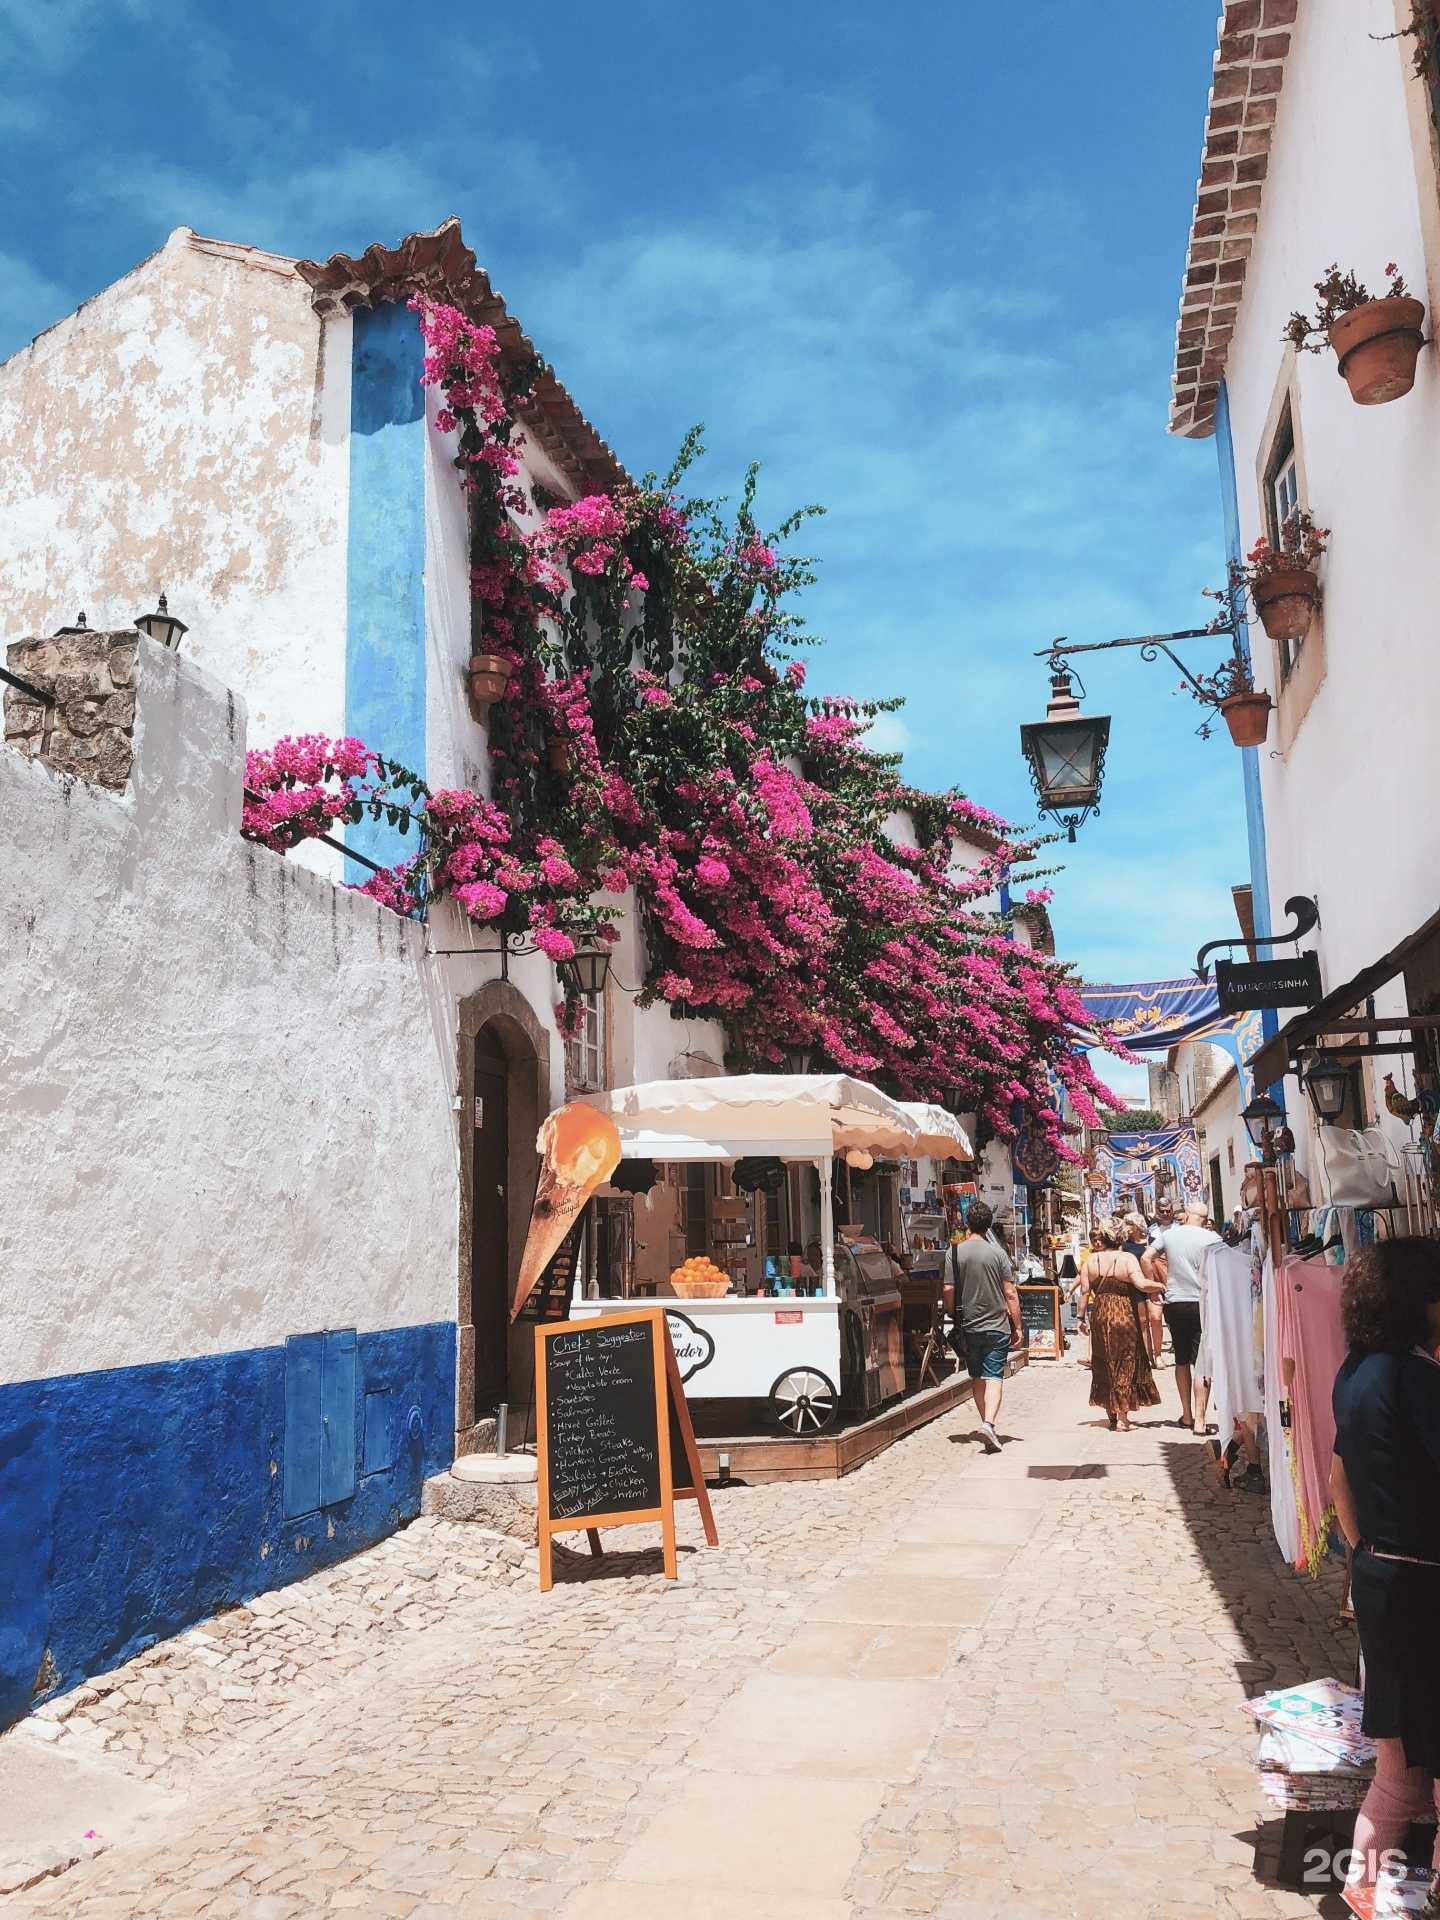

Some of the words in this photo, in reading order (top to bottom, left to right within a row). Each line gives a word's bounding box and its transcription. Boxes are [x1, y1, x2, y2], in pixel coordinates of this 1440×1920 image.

[552, 1333, 591, 1354] Chef's
[597, 1329, 646, 1349] Suggestion
[575, 1354, 582, 1367] of
[598, 1365, 622, 1377] Verde
[557, 1406, 594, 1418] Salmon
[558, 1432, 586, 1446] Turkey
[557, 1445, 593, 1458] Chicken
[600, 1438, 634, 1451] Steaks
[608, 1464, 638, 1478] Exotic
[553, 1499, 585, 1516] Thank
